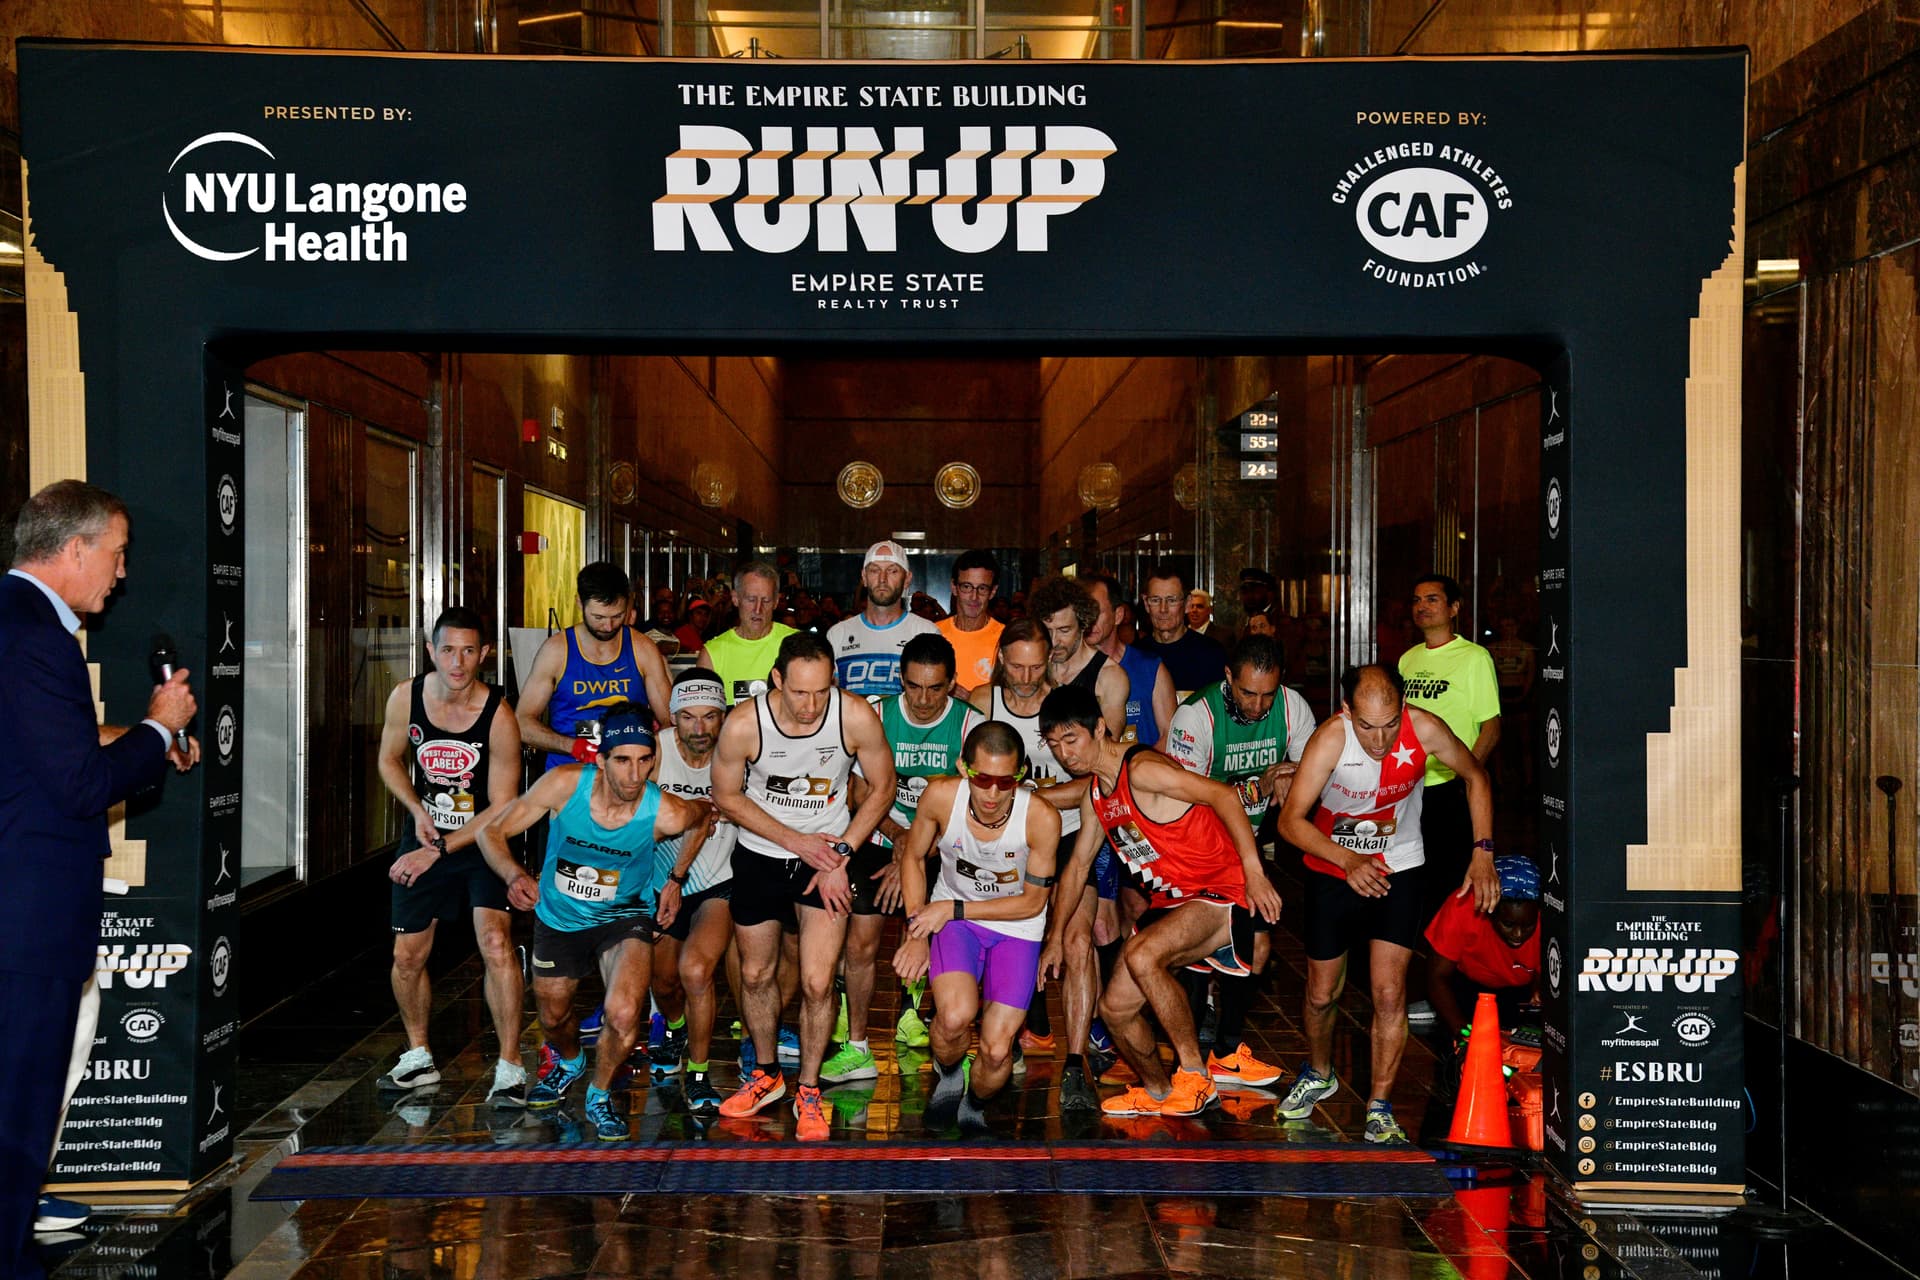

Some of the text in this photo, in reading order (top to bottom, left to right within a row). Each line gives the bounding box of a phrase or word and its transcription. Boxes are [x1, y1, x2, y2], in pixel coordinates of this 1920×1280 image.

[678, 85, 1086, 107] THE EMPIRE STATE BUILDING
[265, 106, 412, 121] PRESENTED BY:
[1356, 111, 1486, 125] POWERED BY:
[1332, 142, 1513, 210] CHALLENGED ATHLETES
[186, 173, 467, 222] NYU Langone
[1367, 192, 1474, 238] CAF
[265, 220, 408, 261] Health
[1362, 259, 1481, 287] FOUNDATION
[792, 272, 984, 292] EMPIRE STATE
[818, 299, 960, 309] REALTY TRUST
[573, 679, 631, 695] DWRT
[425, 758, 465, 770] LABELS
[895, 751, 948, 770] MEXICO
[1223, 747, 1277, 772] MEXICO
[565, 836, 632, 857] SCARPA
[1338, 836, 1388, 850] Bekkali
[567, 880, 601, 898] Ruga
[974, 881, 1000, 893] Soh
[116, 917, 155, 928] STATE
[1616, 921, 1702, 932] EMPIRE STATE
[101, 927, 141, 937] LDING
[1629, 931, 1689, 941] BUILDING
[128, 1019, 156, 1032] CAF
[1680, 1023, 1707, 1035] CAF
[1601, 1038, 1660, 1048] myfitnesspal
